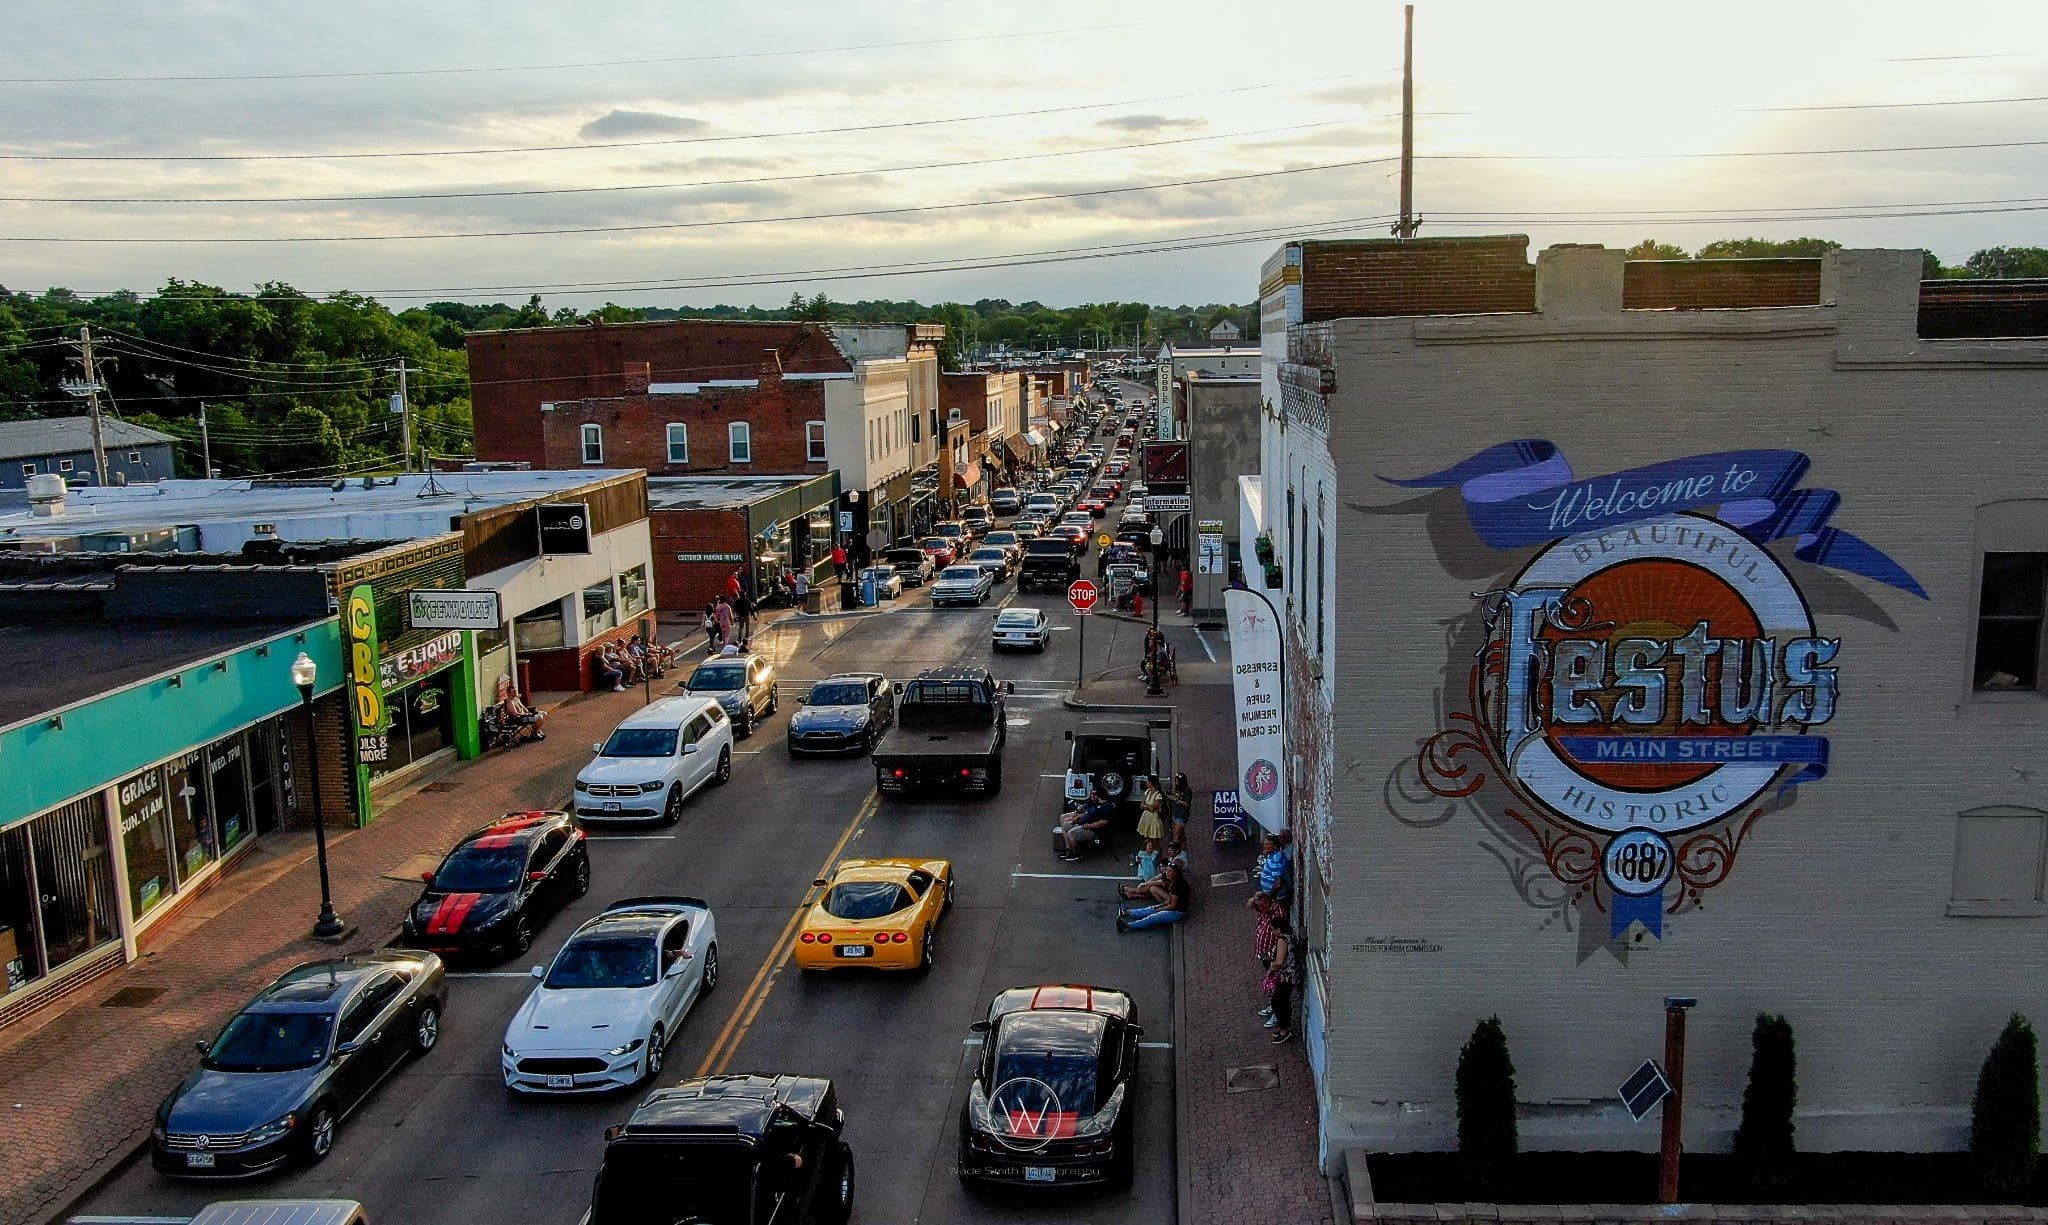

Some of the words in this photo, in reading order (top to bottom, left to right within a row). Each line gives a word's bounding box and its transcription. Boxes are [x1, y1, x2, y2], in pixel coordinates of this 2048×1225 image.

[1161, 365, 1169, 404] COBBLE
[1145, 497, 1190, 505] Information
[1528, 475, 1714, 531] Welcome
[1721, 463, 1758, 494] to
[1571, 525, 1761, 583] BEAUTIFUL
[1070, 589, 1095, 601] STOP
[351, 597, 381, 728] CBD
[398, 632, 462, 671] E-LIQUID
[1471, 584, 1843, 772] Festus
[360, 749, 388, 763] MORE
[379, 736, 388, 749] &
[1596, 741, 1666, 758] MAIN
[1678, 740, 1785, 758] STREET
[121, 769, 158, 806] GRACE
[1214, 791, 1238, 804] ACA
[1561, 784, 1730, 824] HISTORIC
[121, 813, 141, 835] SUN.
[142, 805, 150, 820] 11
[149, 795, 164, 815] AM
[1214, 803, 1243, 814] bowls
[1614, 842, 1668, 883] 1887
[1352, 944, 1377, 953] FESTUS
[1377, 944, 1405, 953] TOURISM
[1405, 944, 1443, 953] COMMISSION
